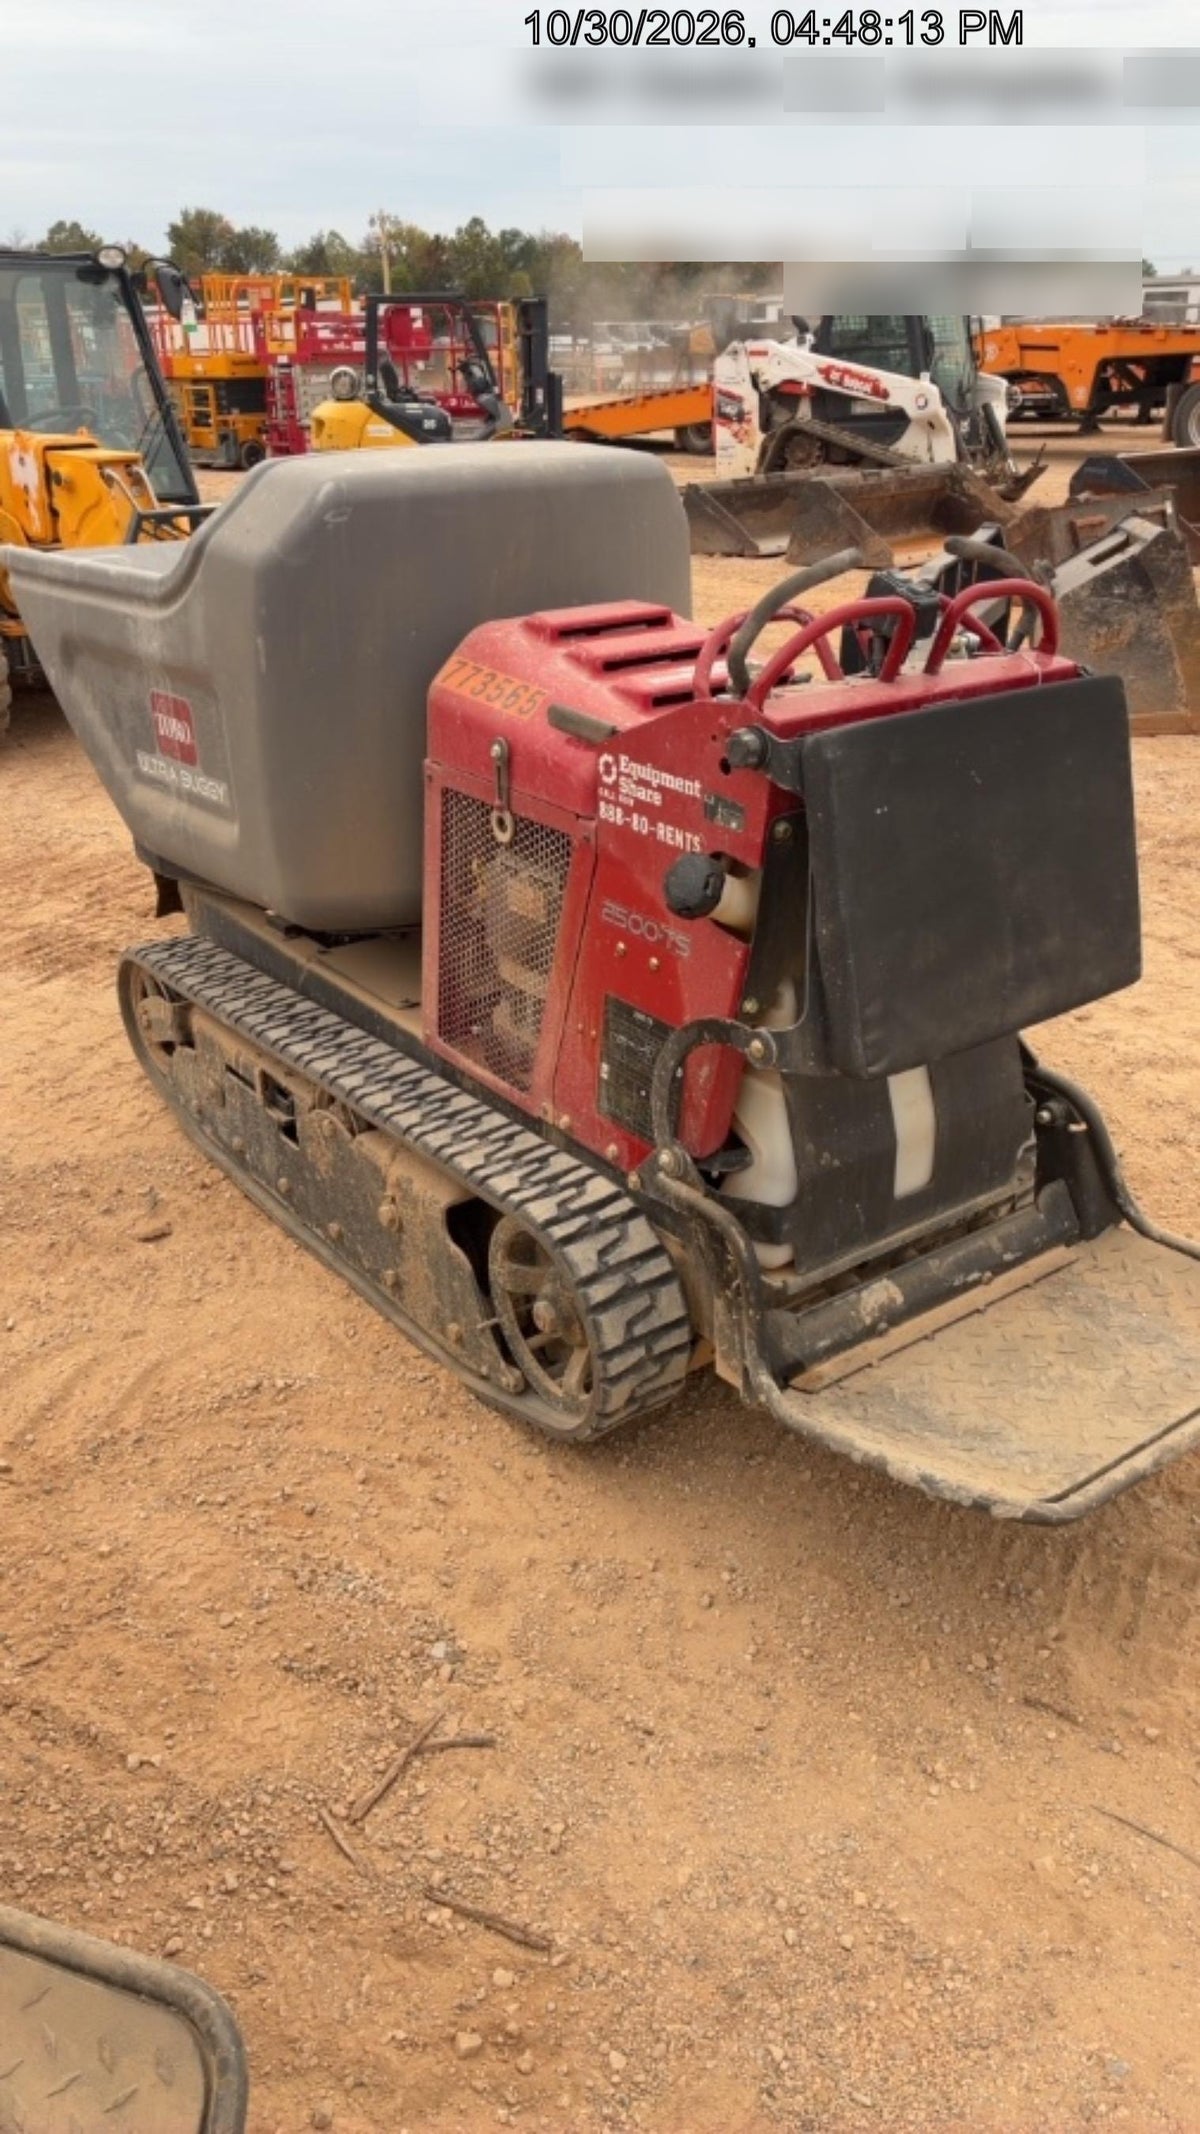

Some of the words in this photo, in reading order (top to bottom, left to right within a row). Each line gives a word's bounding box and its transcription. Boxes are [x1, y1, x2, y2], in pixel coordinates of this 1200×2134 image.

[441, 659, 546, 715] 773565
[136, 750, 179, 785] ULTRA
[181, 769, 228, 802] BUGGY
[618, 754, 702, 798] Equipment
[618, 775, 663, 807] Share
[599, 801, 701, 853] 888-80-RENTS
